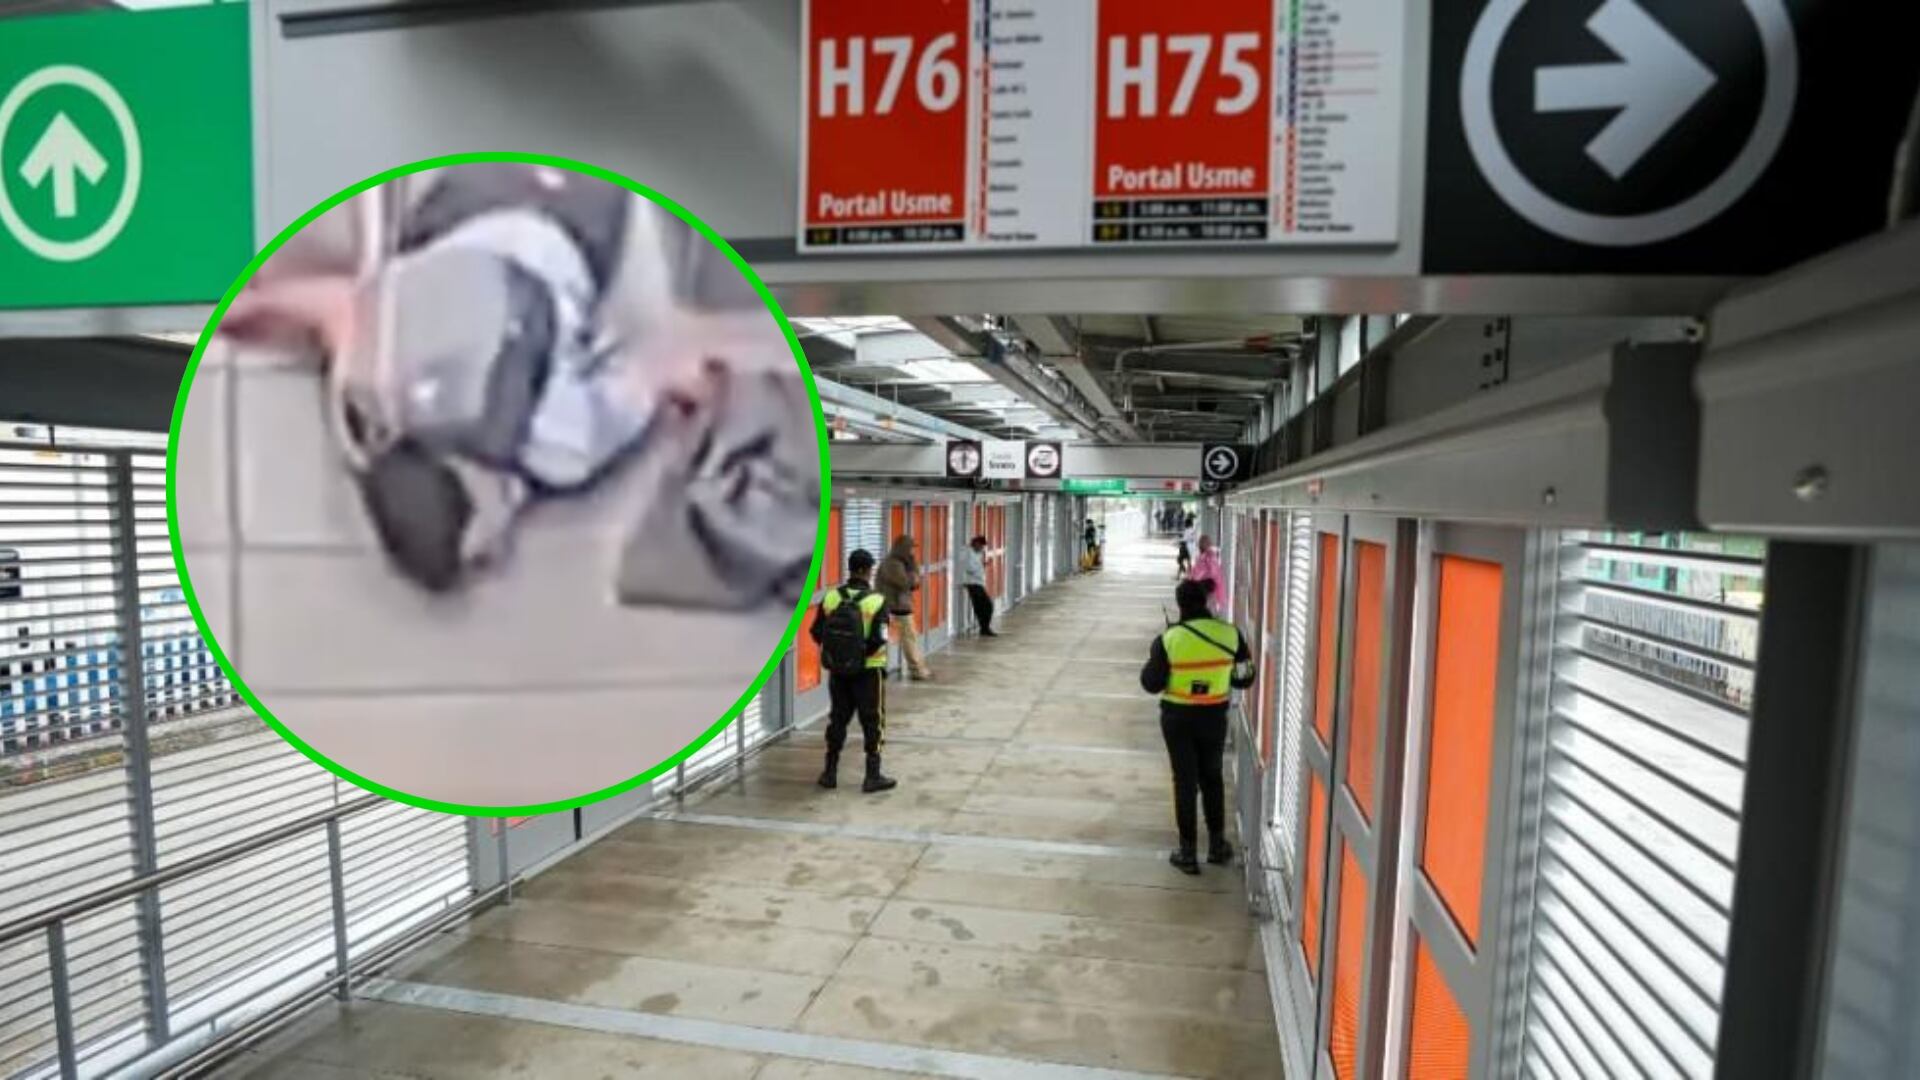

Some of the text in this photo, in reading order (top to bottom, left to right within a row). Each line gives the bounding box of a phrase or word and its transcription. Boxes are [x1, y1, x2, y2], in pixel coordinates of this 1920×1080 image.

[818, 32, 961, 118] H76
[1106, 32, 1261, 118] H75
[818, 190, 953, 218] Portal Usme
[1107, 162, 1255, 190] Portal Usme
